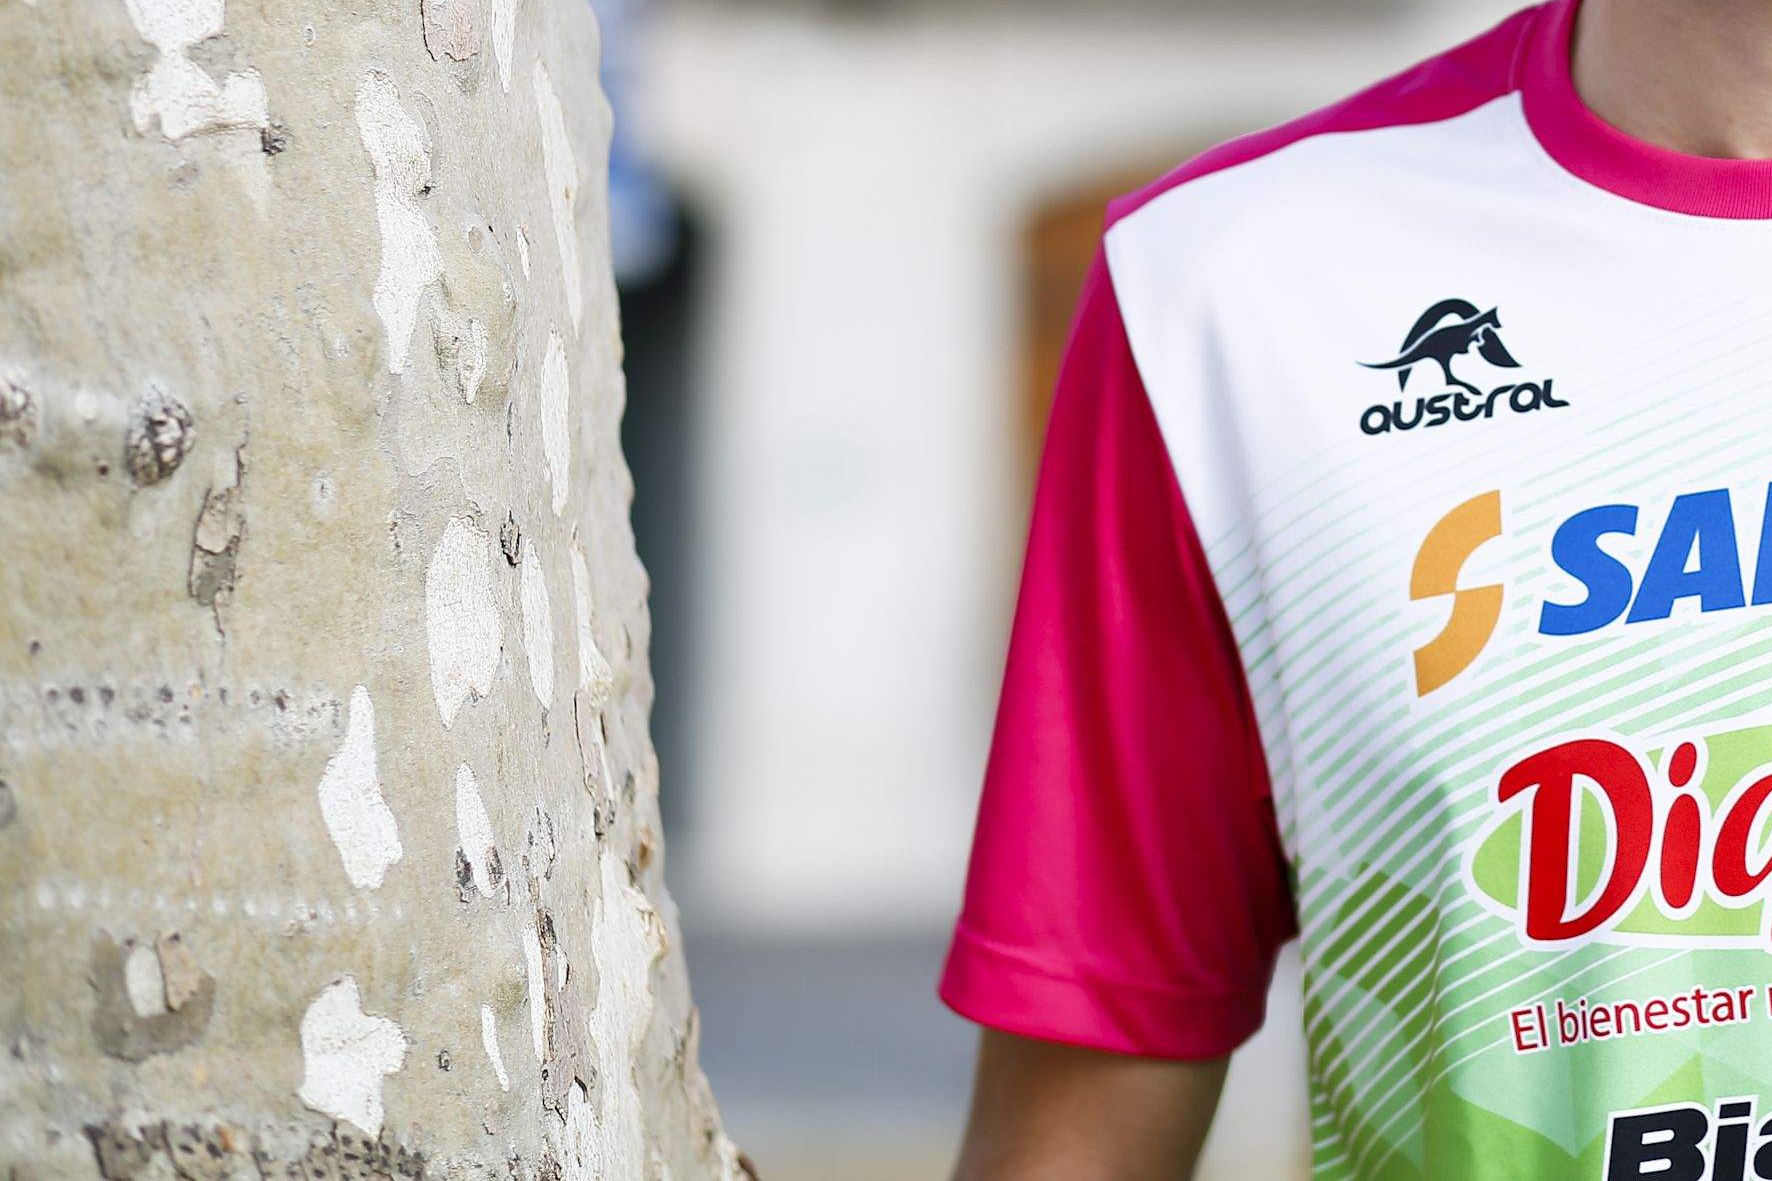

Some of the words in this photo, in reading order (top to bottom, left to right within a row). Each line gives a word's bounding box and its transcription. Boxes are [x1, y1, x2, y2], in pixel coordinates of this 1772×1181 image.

[1360, 379, 1570, 435] austral
[1511, 1006, 1549, 1051] El
[1558, 986, 1752, 1043] bienestar
